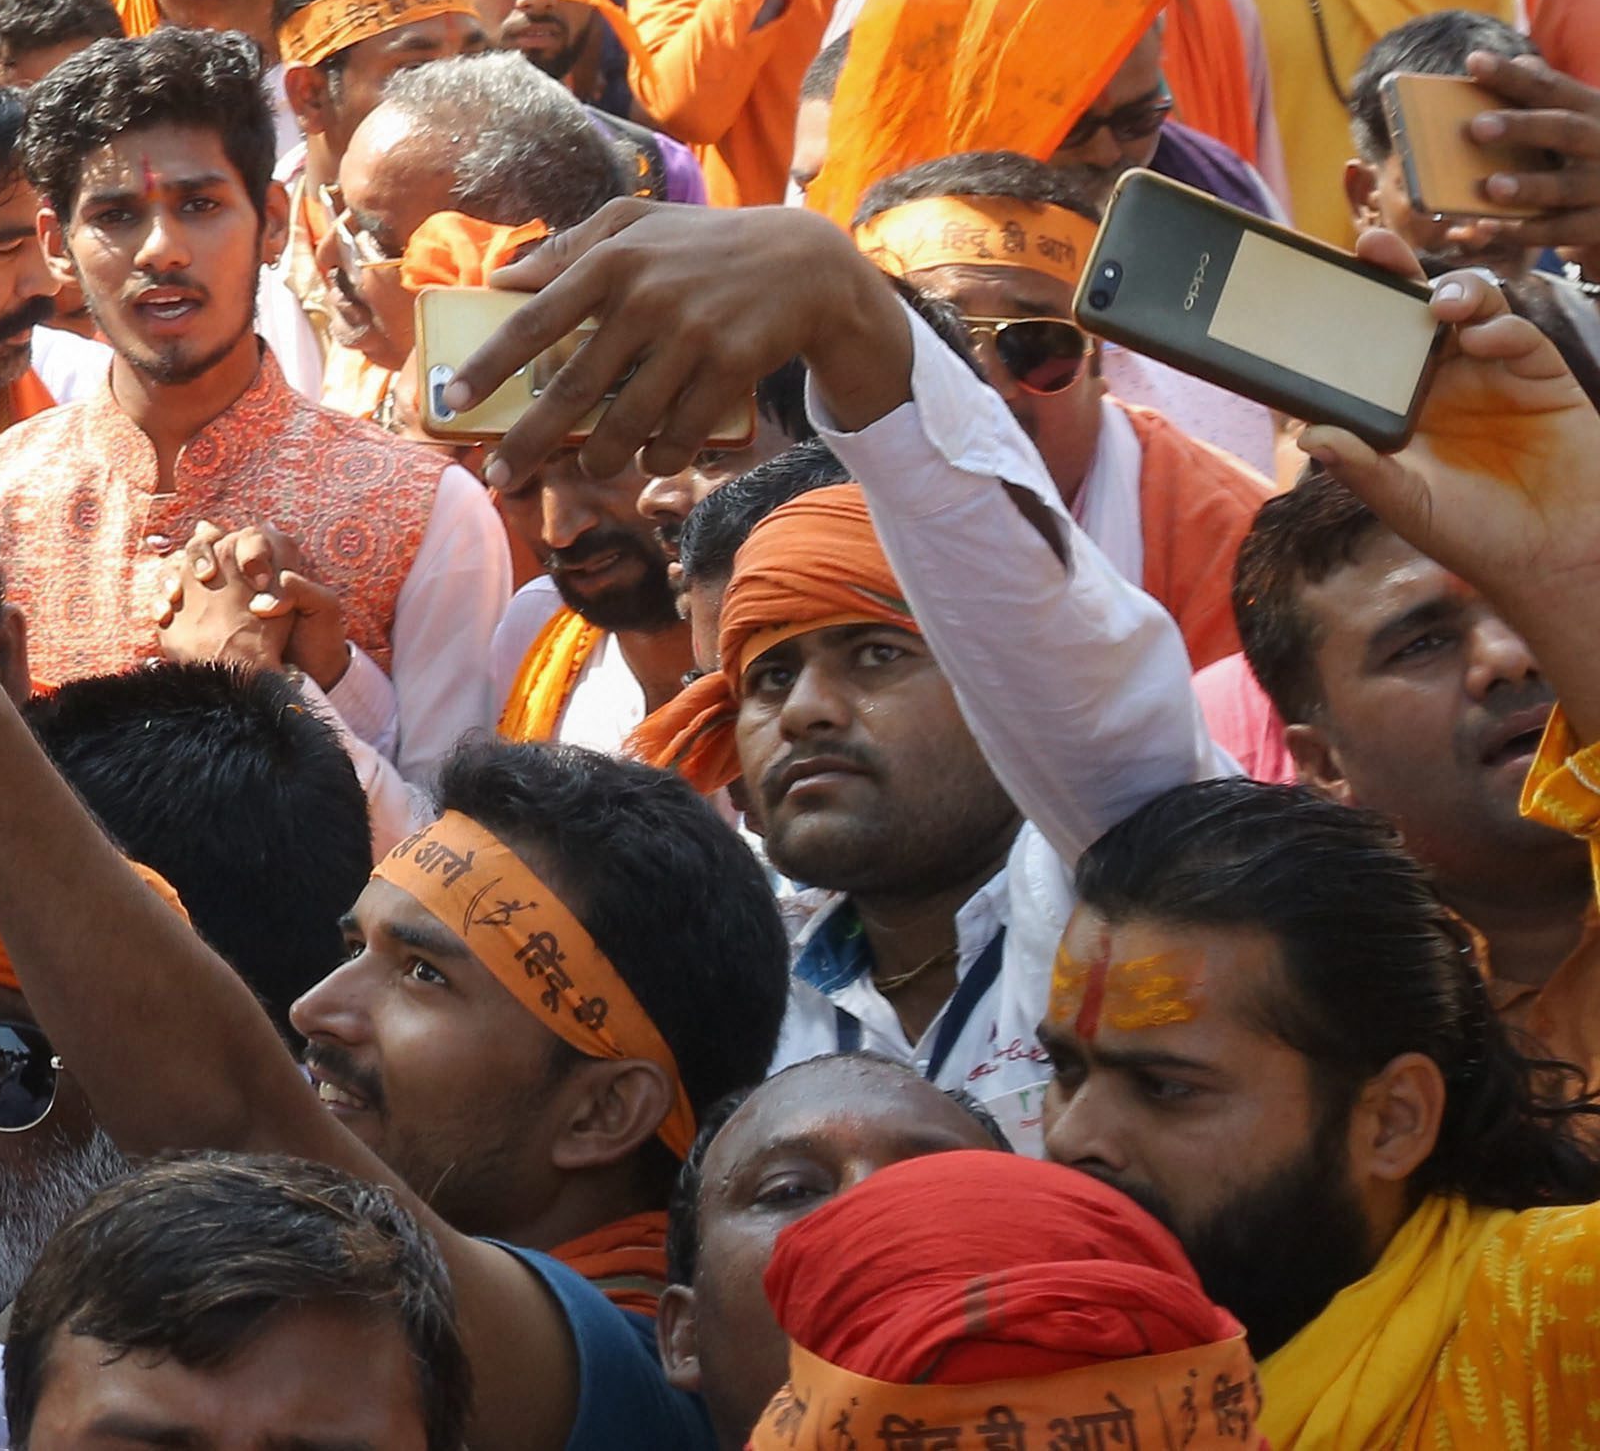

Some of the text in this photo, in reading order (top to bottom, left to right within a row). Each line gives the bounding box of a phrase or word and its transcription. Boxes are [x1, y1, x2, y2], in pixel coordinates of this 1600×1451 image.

[943, 220, 995, 259] हिंदू
[1000, 220, 1027, 253] ही
[414, 840, 476, 887] आगे
[513, 931, 576, 1014] हिंदू
